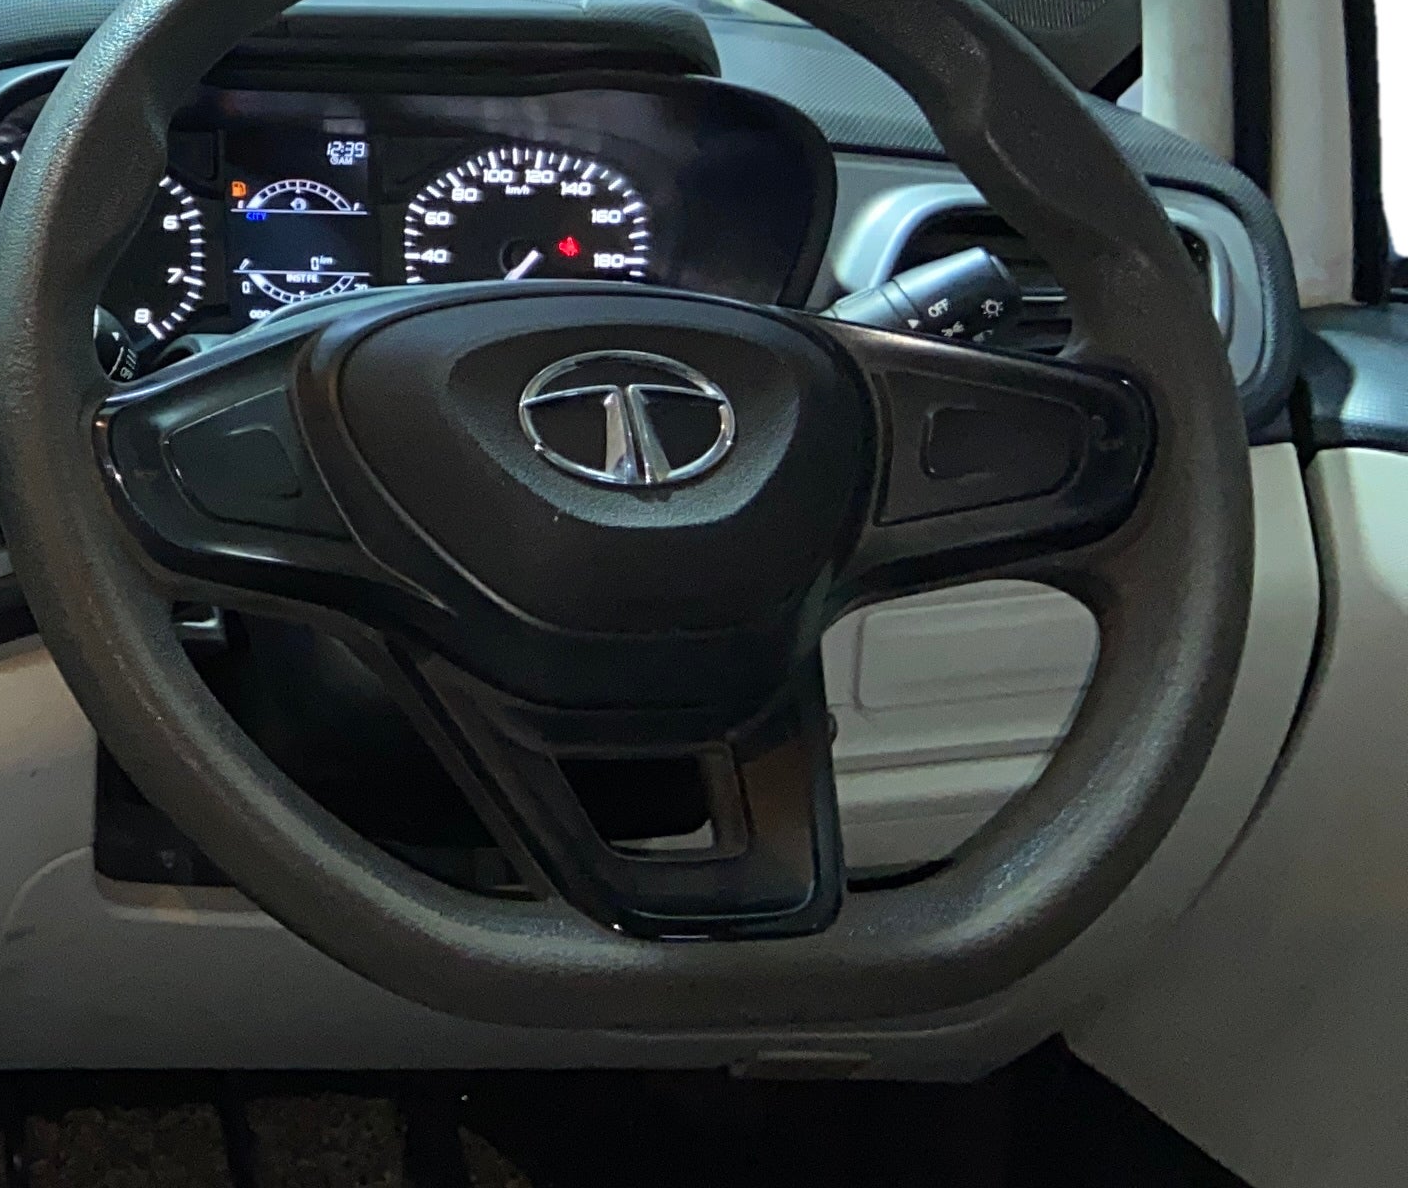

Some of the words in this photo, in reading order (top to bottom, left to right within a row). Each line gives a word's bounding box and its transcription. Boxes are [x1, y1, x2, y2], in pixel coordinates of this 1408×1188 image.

[326, 141, 366, 158] 12:39
[338, 156, 354, 166] AM
[483, 169, 514, 183] 100
[525, 169, 555, 183] 120
[451, 187, 479, 203] 80
[505, 184, 531, 196] km/h
[561, 182, 592, 197] 140
[163, 214, 180, 231] 6
[246, 211, 267, 221] CITY
[424, 211, 451, 226] 60
[591, 209, 622, 224] 160
[310, 256, 320, 271] 0
[421, 249, 449, 263] 40
[593, 254, 625, 268] 180
[167, 267, 184, 284] 7
[241, 280, 251, 294] 0
[134, 307, 151, 324] 8
[927, 298, 949, 318] OFF
